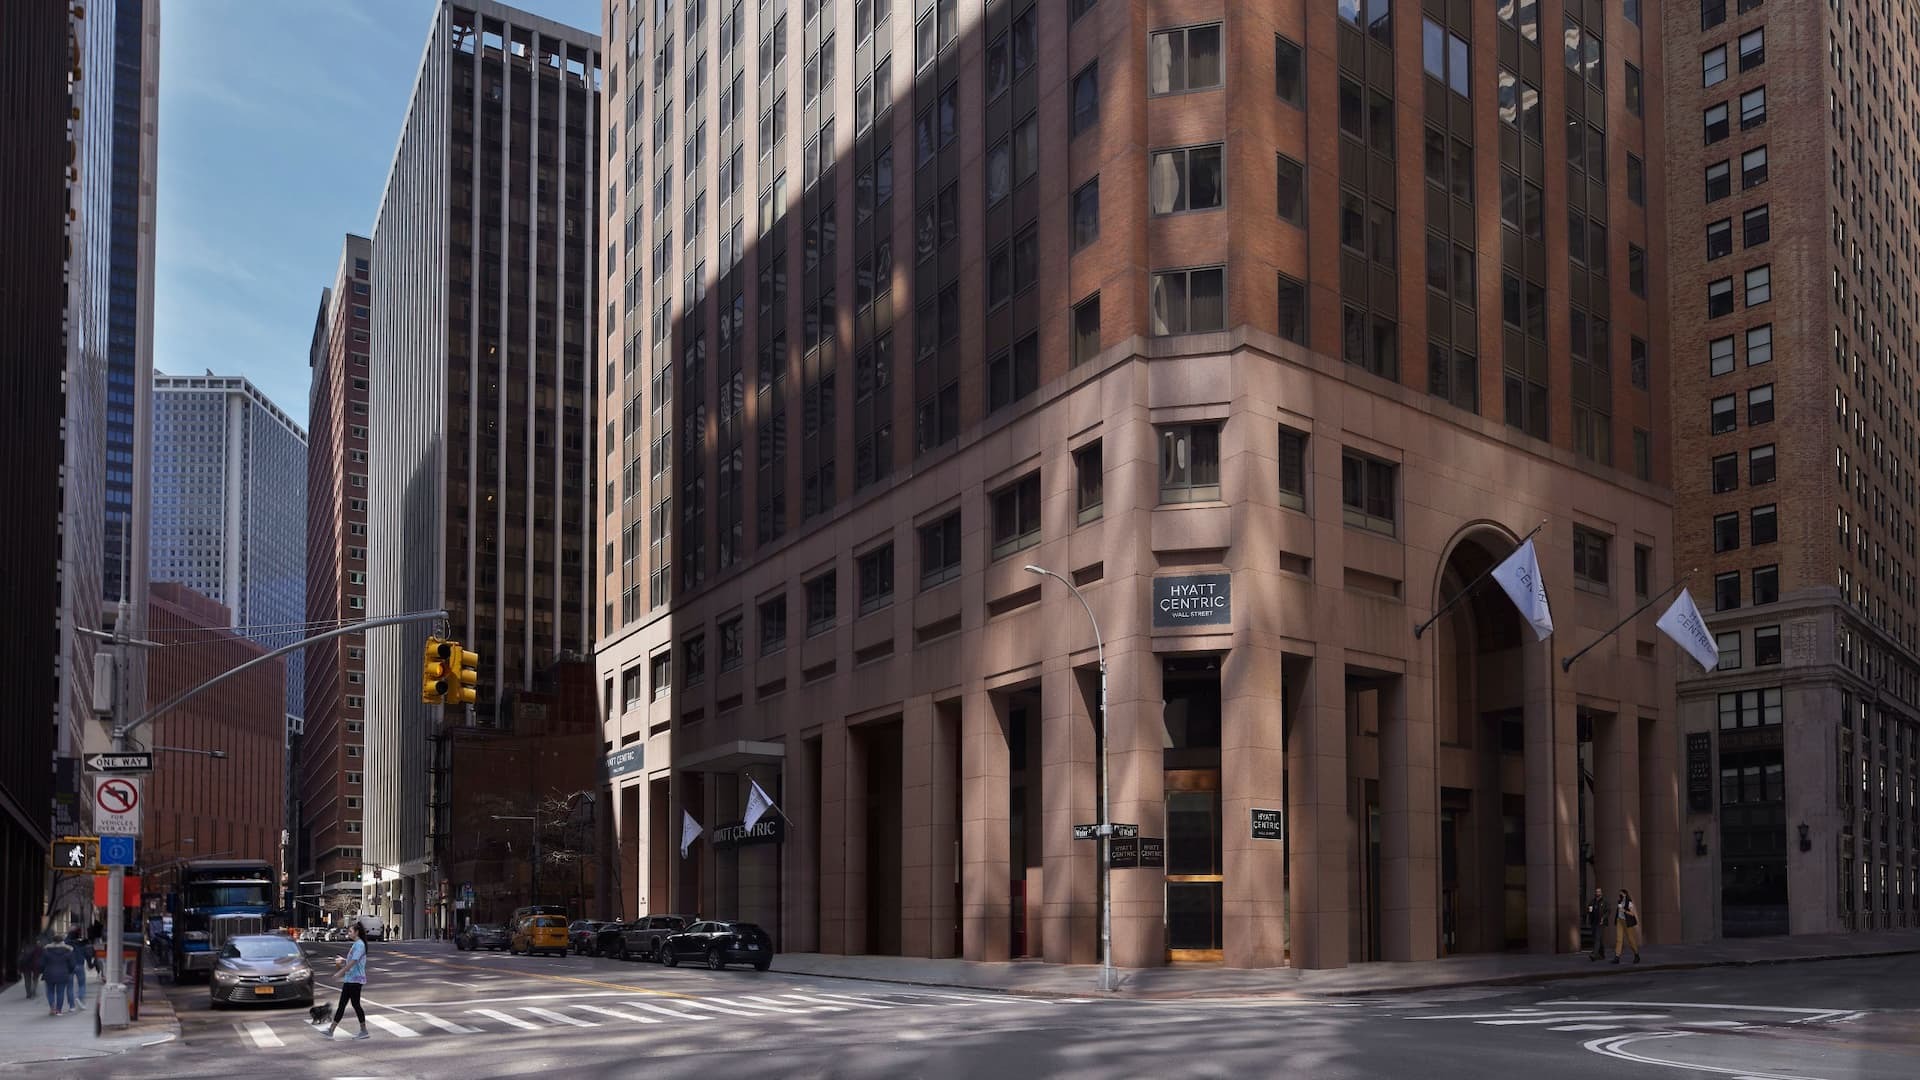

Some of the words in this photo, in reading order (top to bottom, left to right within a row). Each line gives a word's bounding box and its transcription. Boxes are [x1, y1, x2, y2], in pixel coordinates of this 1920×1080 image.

[1171, 583, 1216, 596] HYATT
[1160, 596, 1224, 611] CENTRIC
[97, 758, 117, 767] ONE
[123, 757, 143, 766] WAY
[1257, 813, 1276, 821] HYATT
[1253, 821, 1280, 830] CENTRIC
